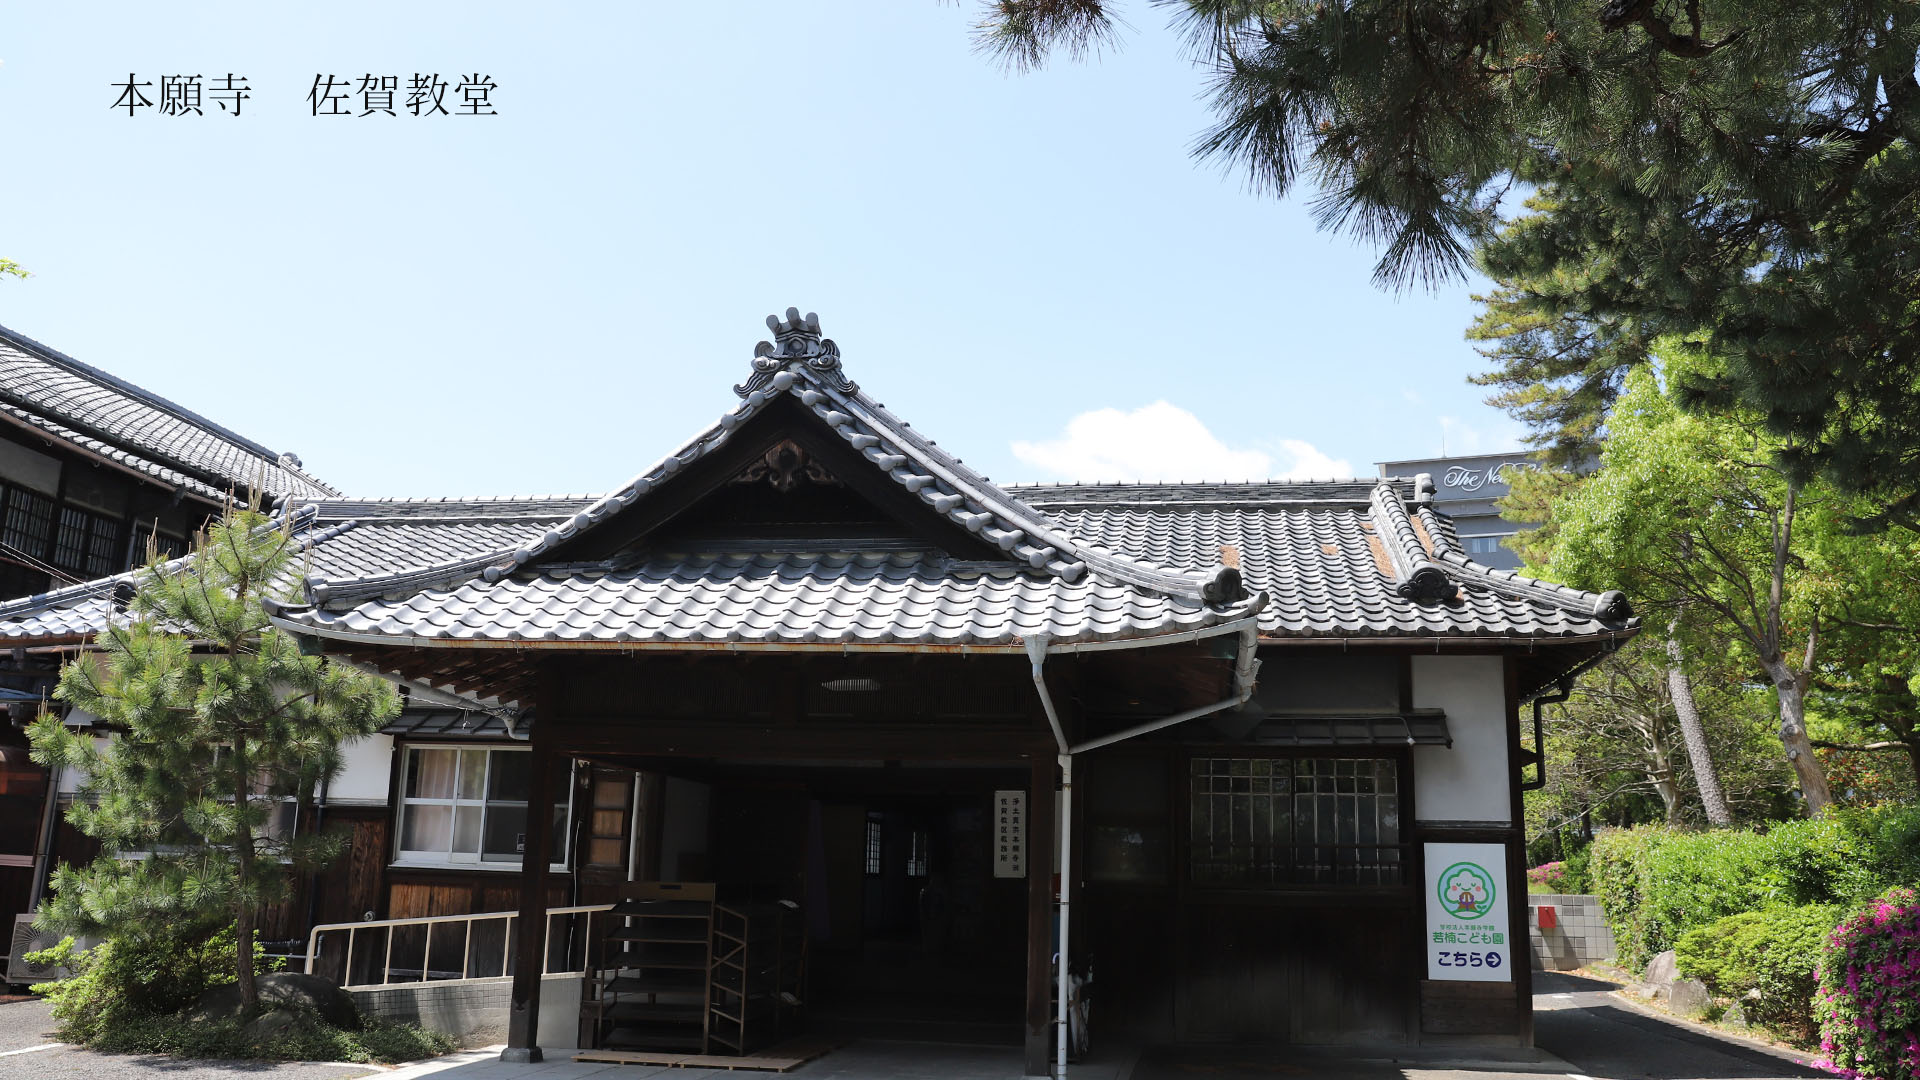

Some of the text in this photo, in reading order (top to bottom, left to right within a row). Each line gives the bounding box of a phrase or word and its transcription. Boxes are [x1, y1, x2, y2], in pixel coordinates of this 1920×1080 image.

[1443, 465, 1482, 488] The
[1432, 931, 1504, 944] 若楠こども園
[1438, 952, 1483, 967] こちら
